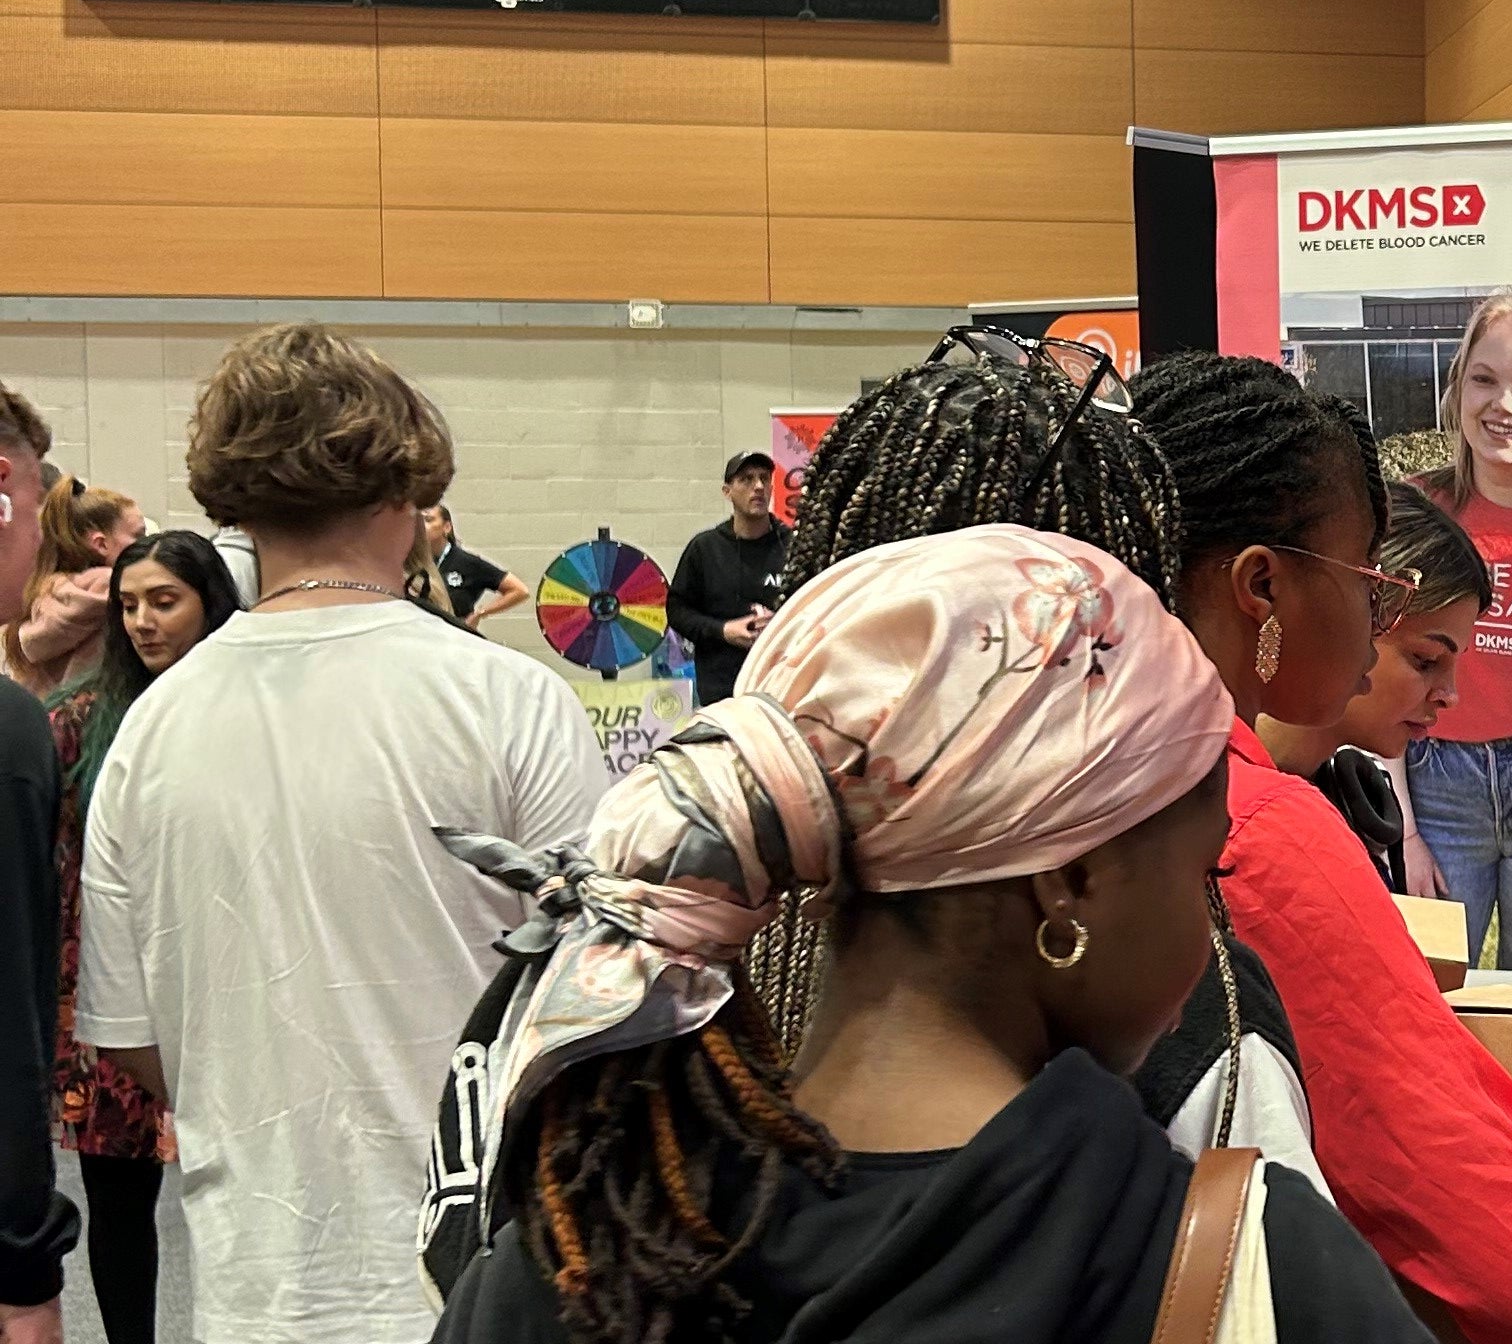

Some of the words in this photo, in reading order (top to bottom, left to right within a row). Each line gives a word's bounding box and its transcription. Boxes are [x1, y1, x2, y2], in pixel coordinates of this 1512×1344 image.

[1298, 186, 1438, 232] DKMS
[1299, 240, 1321, 252] WE
[1325, 238, 1374, 251] DELETE
[1379, 236, 1425, 249] BLOOD
[1429, 234, 1486, 247] CANCER
